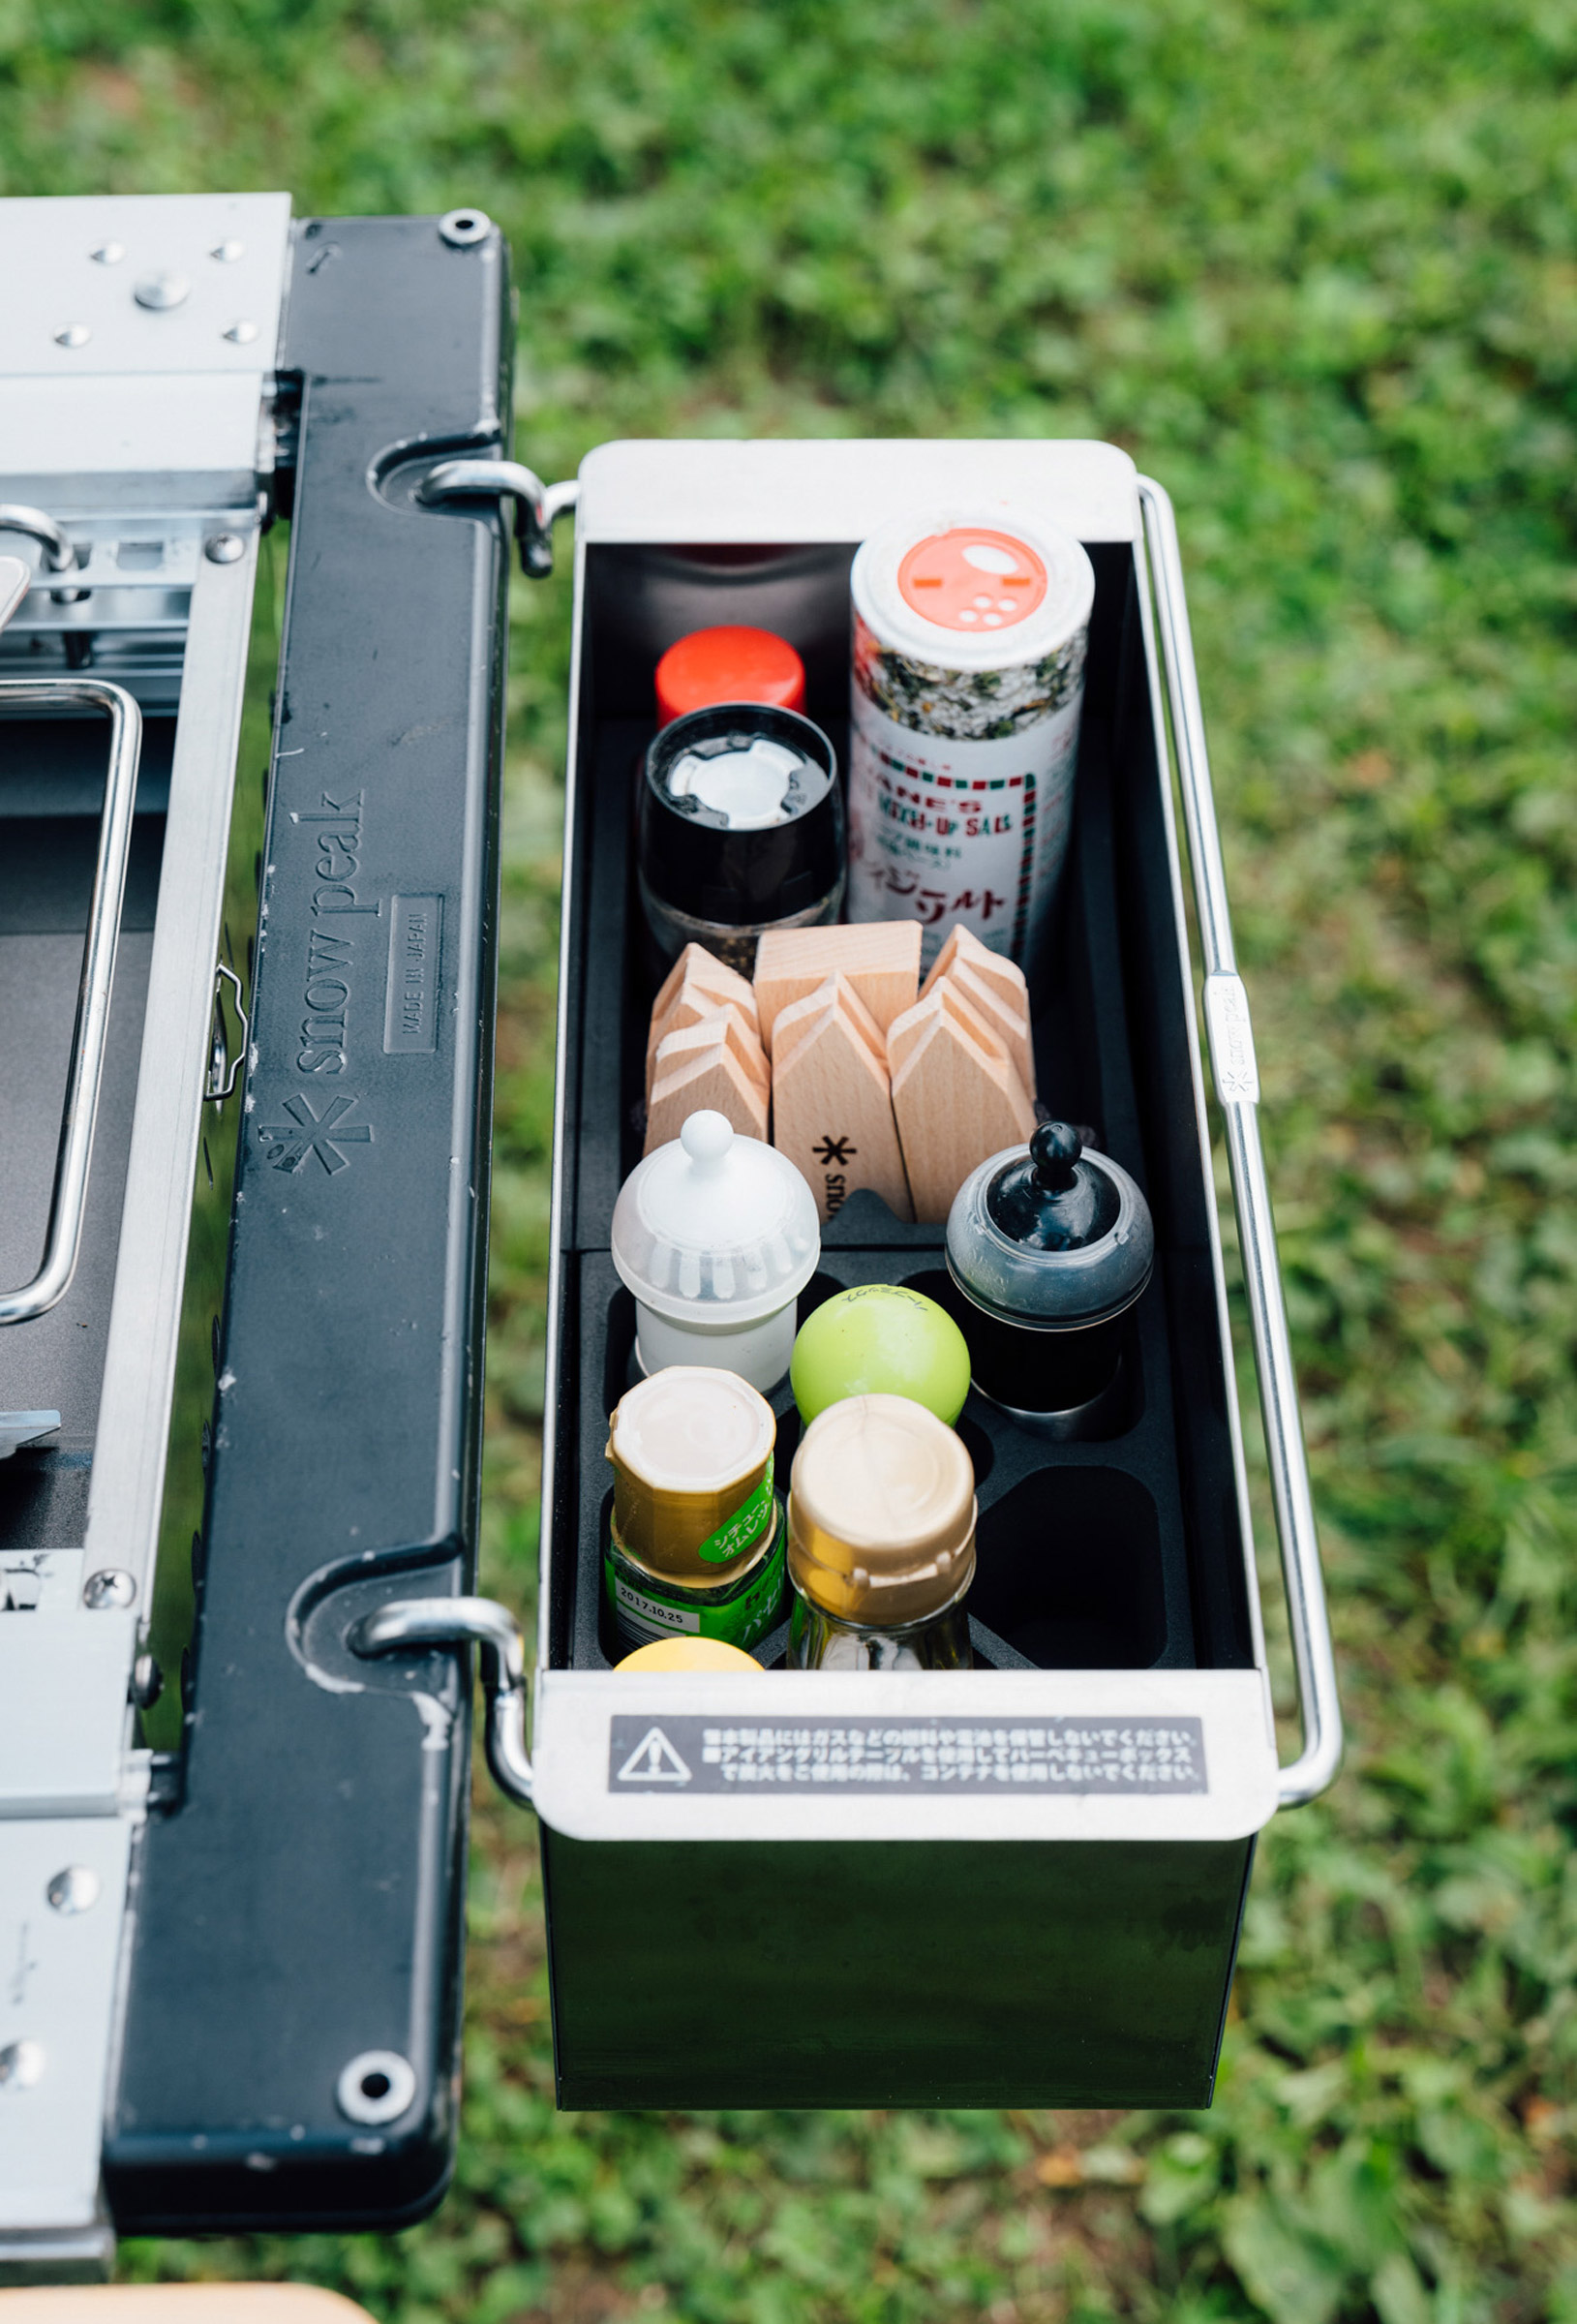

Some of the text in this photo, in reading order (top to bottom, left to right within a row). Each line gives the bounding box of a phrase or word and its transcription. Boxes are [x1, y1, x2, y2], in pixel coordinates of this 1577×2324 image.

[288, 789, 382, 1076] snow peak
[401, 912, 429, 1035] MADE IN JAPAN
[825, 1173, 846, 1219] sno
[620, 1586, 684, 1624] 2017.10.25
